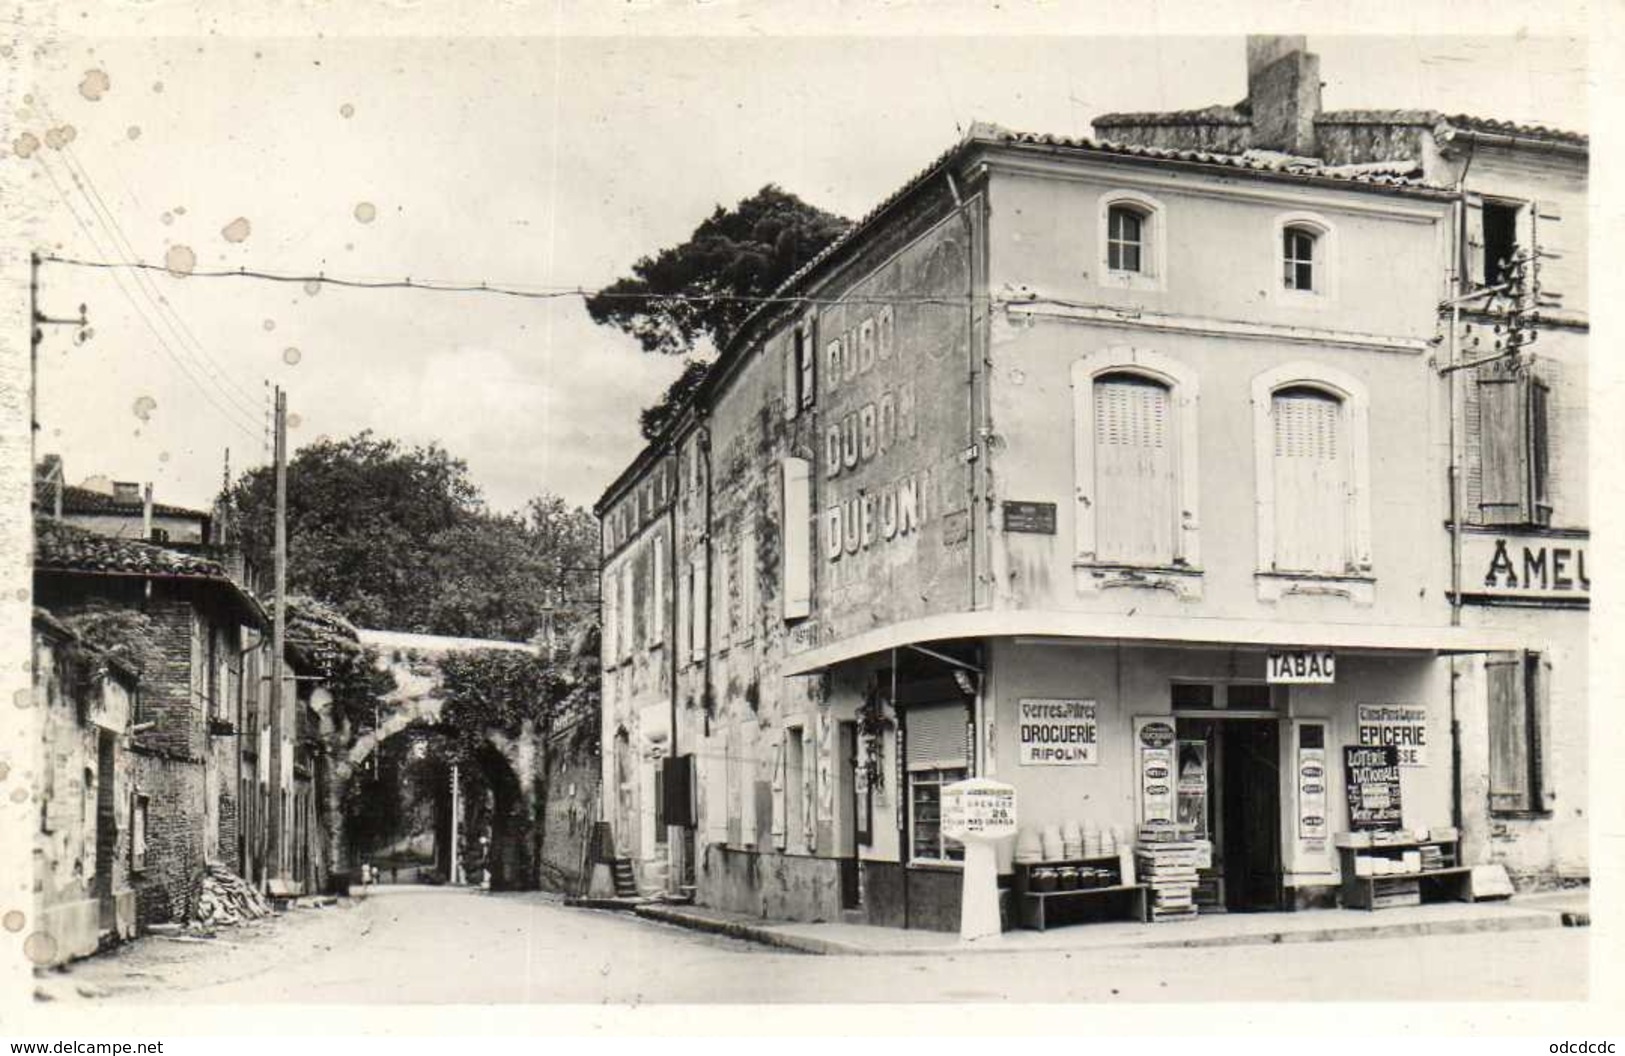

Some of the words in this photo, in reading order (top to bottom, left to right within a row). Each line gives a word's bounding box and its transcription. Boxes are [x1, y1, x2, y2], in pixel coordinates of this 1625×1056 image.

[1269, 654, 1333, 677] TABAC
[1021, 724, 1096, 743] DROGUERIE
[1360, 725, 1426, 746] EPICERIE
[1031, 748, 1087, 760] RIPOLIN
